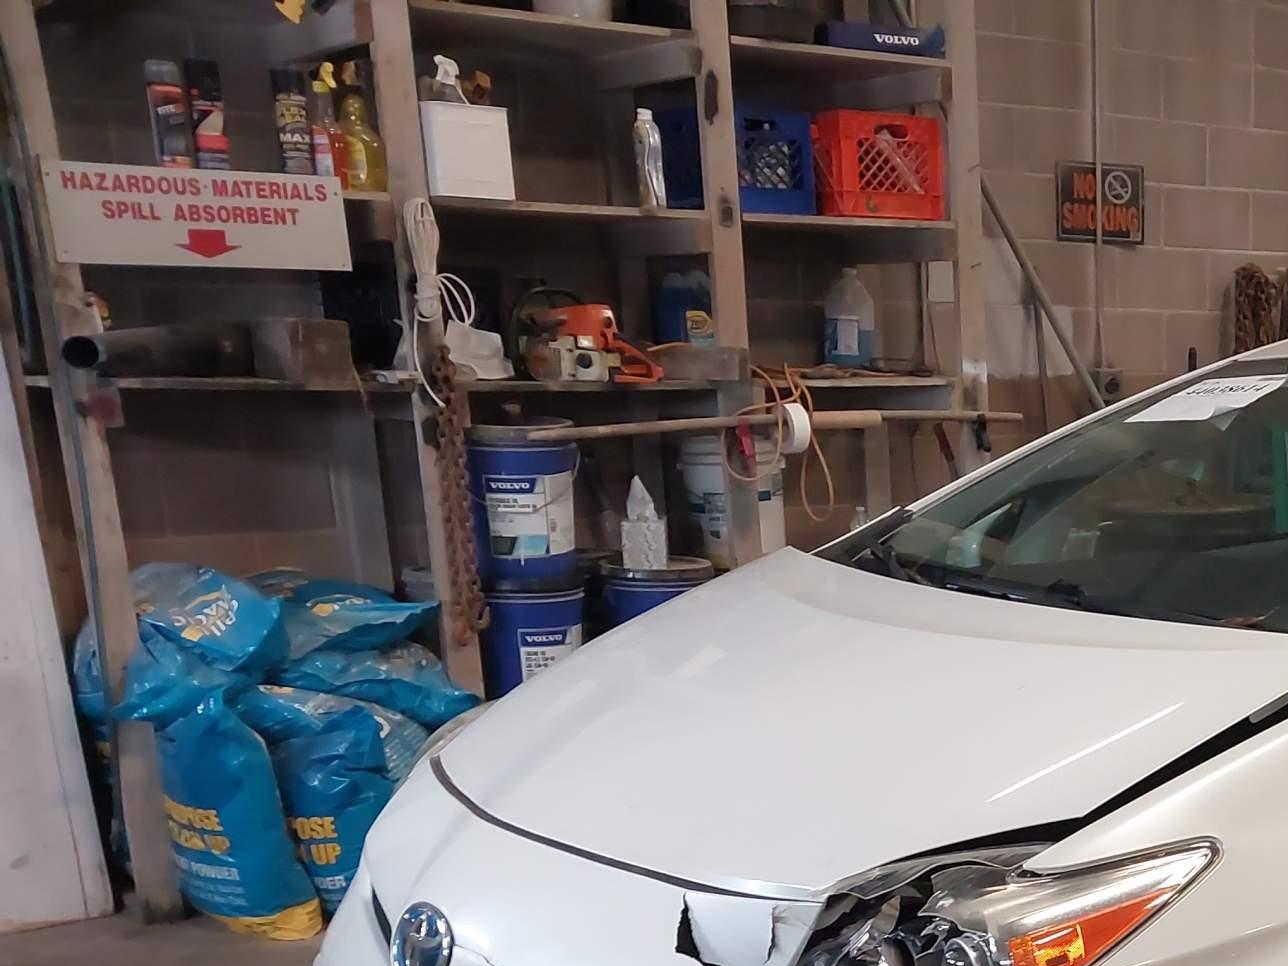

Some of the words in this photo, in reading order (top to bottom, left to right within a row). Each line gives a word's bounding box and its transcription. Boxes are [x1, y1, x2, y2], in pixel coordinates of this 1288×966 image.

[873, 33, 920, 46] VOLVO
[280, 132, 312, 143] MAX
[60, 170, 200, 197] HAZARDOUS
[212, 179, 328, 202] MATERIALS
[1072, 172, 1096, 200] NO
[101, 200, 161, 221] SPILL
[174, 204, 300, 226] ABSORBENT
[1063, 202, 1138, 232] SMOKING
[489, 481, 530, 490] VOLVO
[524, 634, 563, 643] VOLVO
[310, 843, 342, 865] UP
